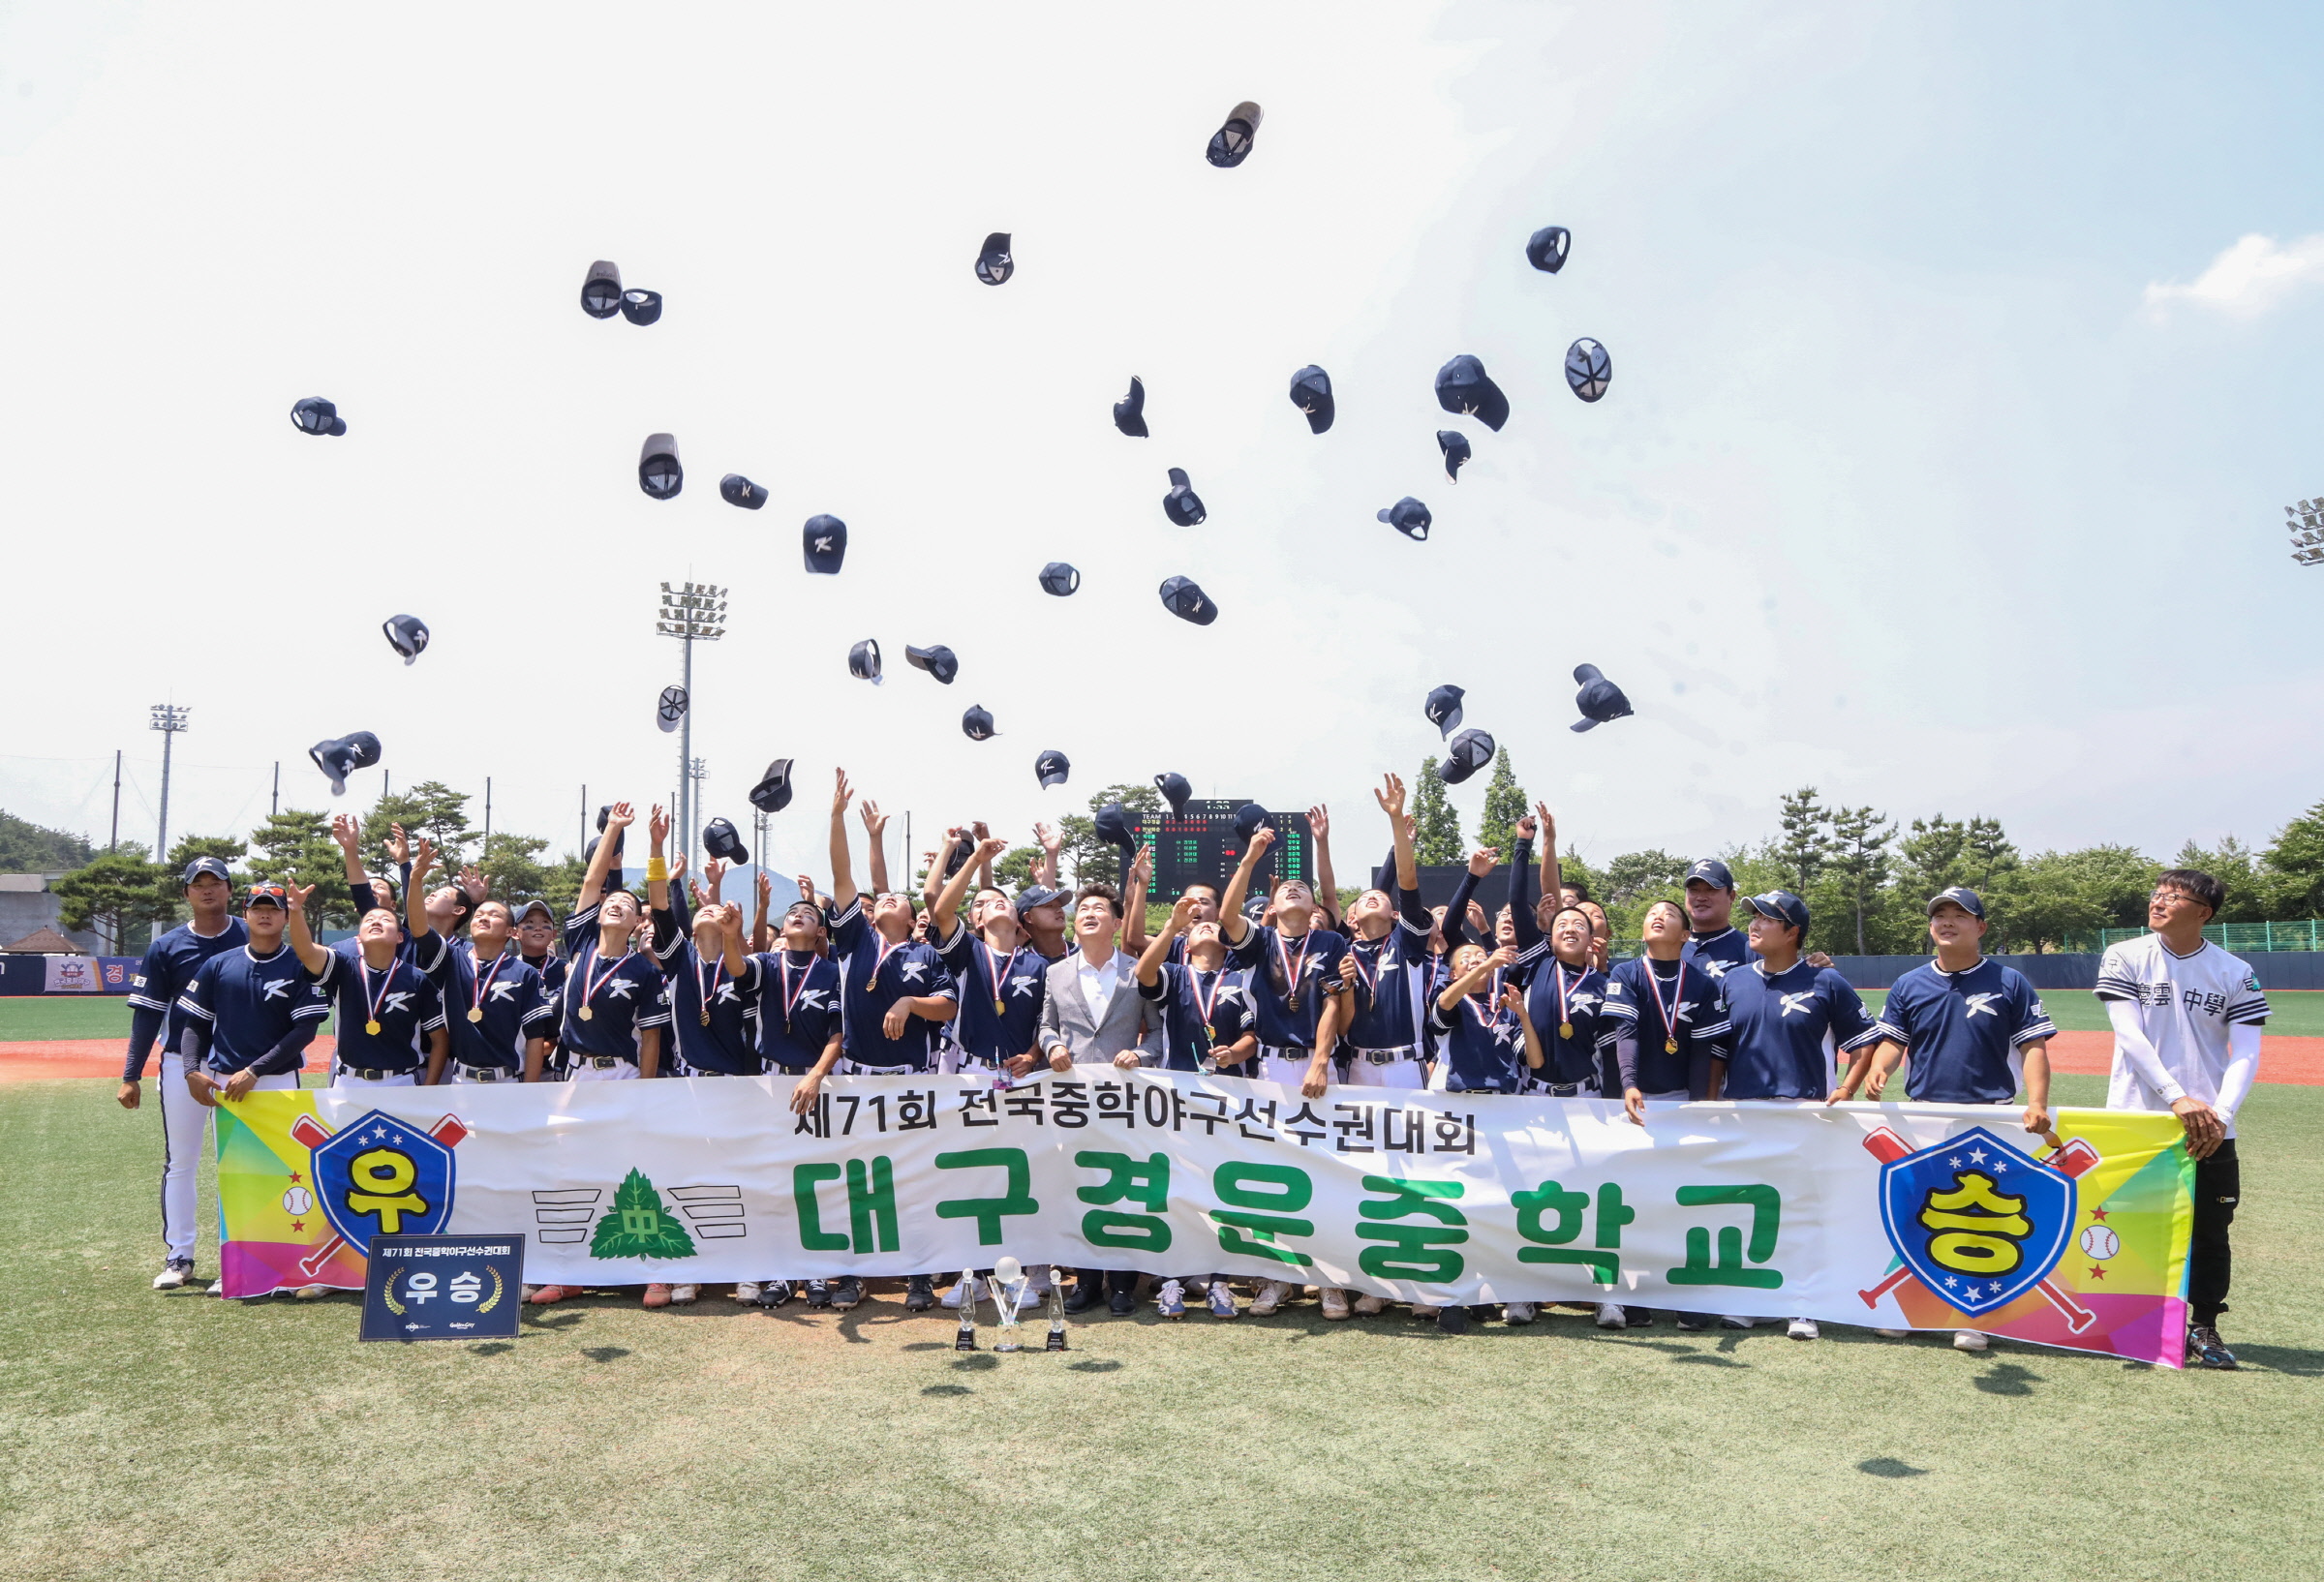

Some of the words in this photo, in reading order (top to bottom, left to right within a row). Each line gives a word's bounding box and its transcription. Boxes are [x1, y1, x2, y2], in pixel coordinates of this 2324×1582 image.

[107, 964, 123, 984] 경
[794, 1092, 935, 1139] 제71회
[958, 1080, 1477, 1156] 전국중학야구선수권대회
[345, 1146, 430, 1234] 우
[622, 1205, 657, 1237] 中
[1917, 1170, 2034, 1277] 승
[382, 1247, 413, 1258] 제71회
[414, 1246, 510, 1257] 전국중학야구선수권대회
